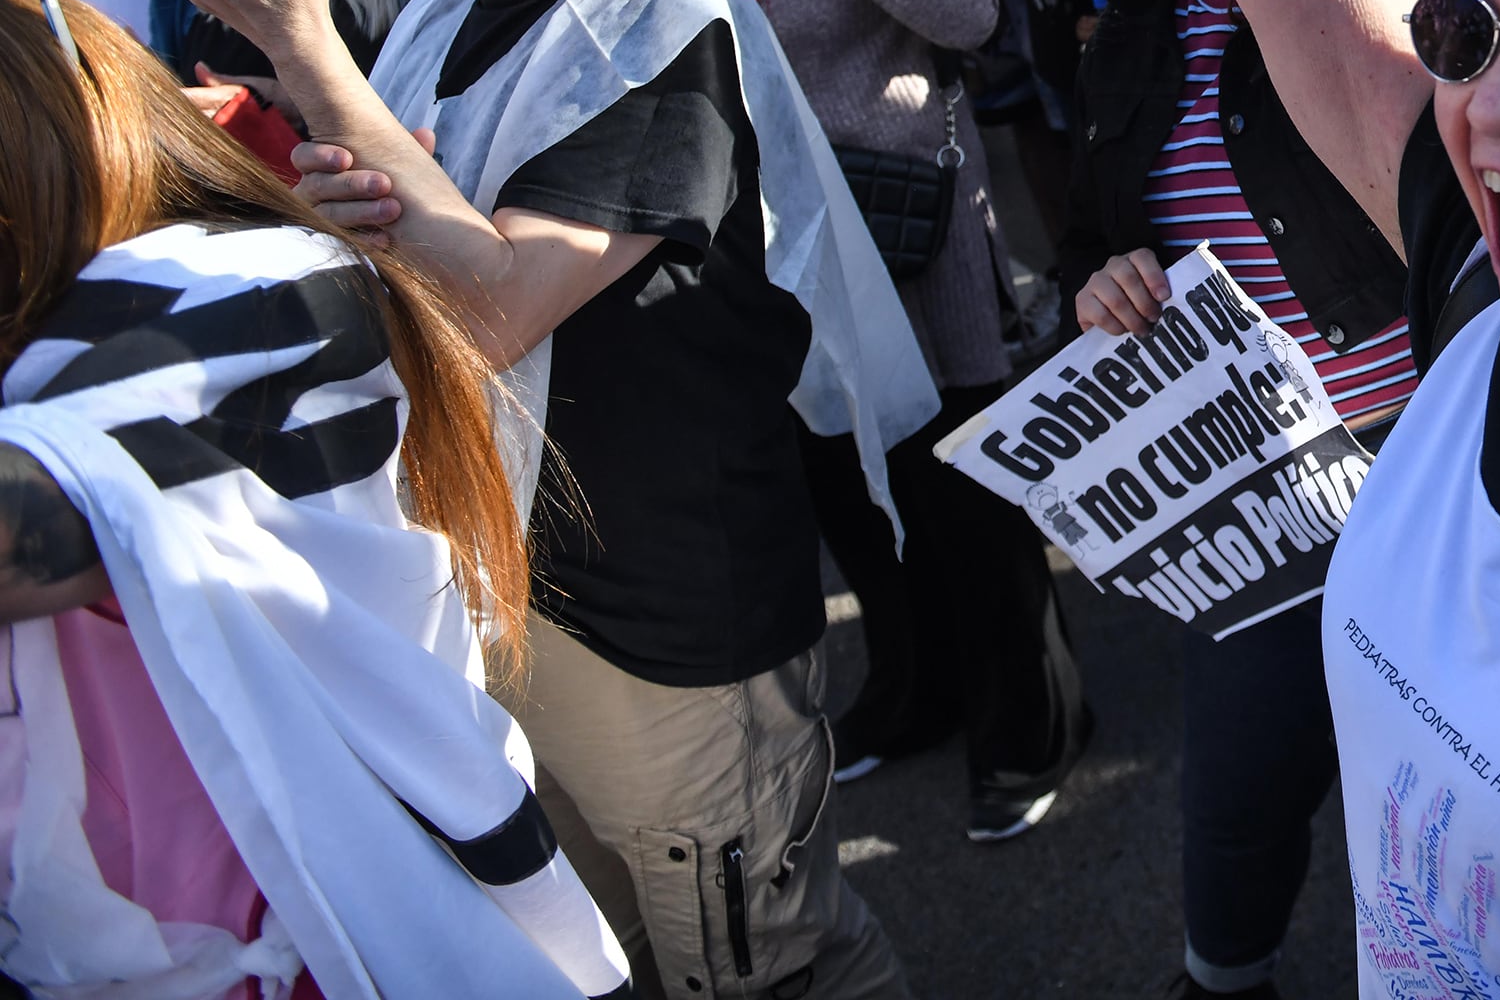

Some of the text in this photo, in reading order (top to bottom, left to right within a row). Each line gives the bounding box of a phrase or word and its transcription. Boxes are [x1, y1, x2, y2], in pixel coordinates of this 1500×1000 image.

[980, 269, 1261, 481] Gobierno que
[1076, 362, 1306, 543] no cumple:
[1344, 617, 1417, 700] PEDIATRAS
[1413, 697, 1472, 761] CONTRA
[1469, 752, 1491, 780] EL
[1380, 880, 1415, 942] acceso
